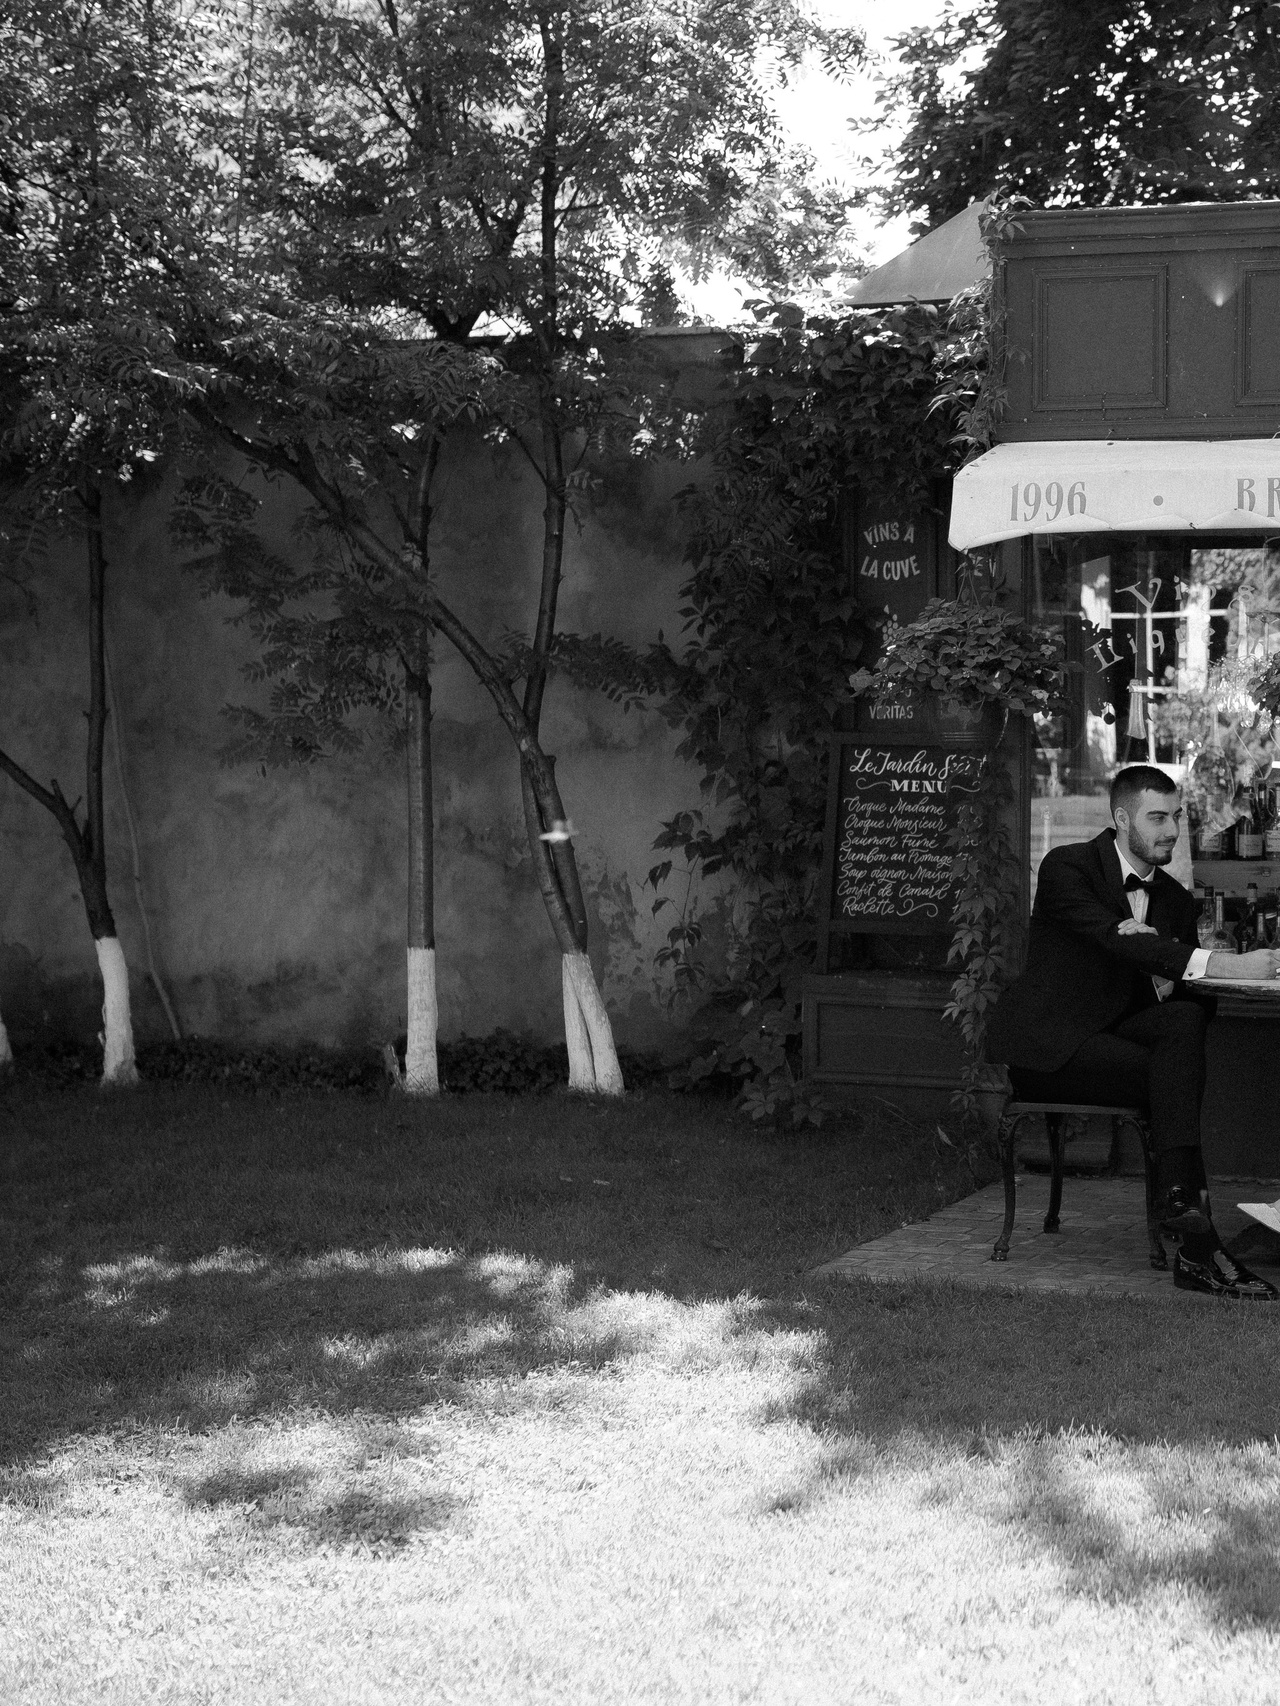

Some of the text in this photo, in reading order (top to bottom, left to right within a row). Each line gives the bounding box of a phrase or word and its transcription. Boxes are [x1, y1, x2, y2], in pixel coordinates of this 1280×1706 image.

[1010, 481, 1088, 522] 1996
[863, 521, 900, 545] VINS
[860, 554, 921, 581] LA CUVE
[849, 748, 874, 773] Le
[873, 749, 938, 776] Jardin
[890, 779, 947, 794] MENU
[843, 795, 887, 818] Croque
[889, 795, 947, 816] Madame
[844, 813, 885, 836] Croque
[886, 814, 948, 835] Monsieur
[841, 830, 940, 849] Saumon Fumé
[838, 846, 889, 864] Jambon
[890, 852, 907, 863] au
[907, 848, 953, 869] Fromage
[870, 865, 910, 884] oignon
[909, 865, 954, 884] Maison
[836, 879, 877, 901] Confit
[877, 883, 894, 898] de
[898, 882, 952, 900] Canard
[842, 896, 896, 917] Raclette
